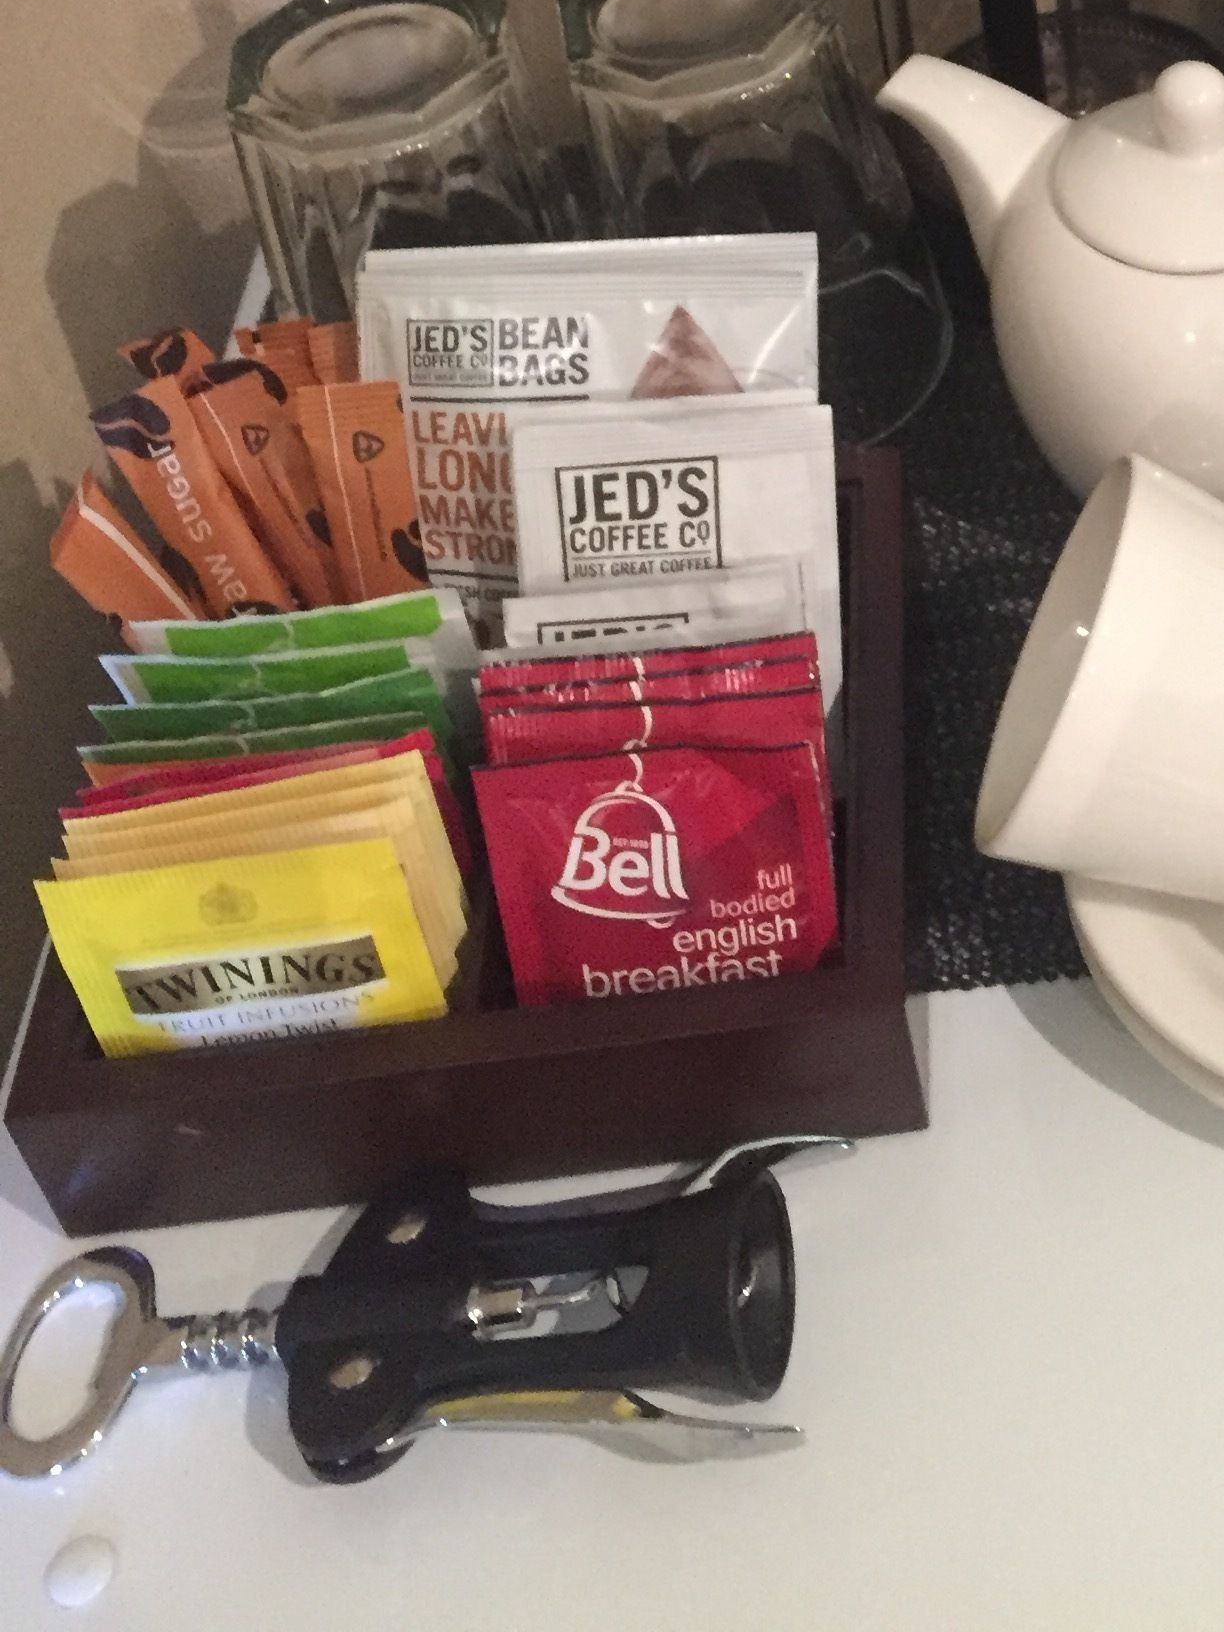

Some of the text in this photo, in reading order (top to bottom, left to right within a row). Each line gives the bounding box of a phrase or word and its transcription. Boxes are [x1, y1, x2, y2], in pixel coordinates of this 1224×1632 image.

[412, 324, 488, 353] JED'S
[499, 317, 590, 350] BEAN
[412, 353, 465, 369] COFFEE
[499, 352, 590, 387] BAGS
[568, 466, 709, 526] JED'S
[569, 522, 669, 555] COFFEE
[572, 555, 714, 579] JUST GREAT COFFEE
[559, 825, 690, 900] Bell
[756, 863, 793, 891] full
[709, 887, 796, 919] bodied
[672, 914, 798, 957] english
[124, 952, 377, 1011] TWININGS
[582, 949, 782, 999] breakfast
[240, 984, 299, 1003] LONDON
[157, 992, 375, 1034] FRUIT INFUSIONS
